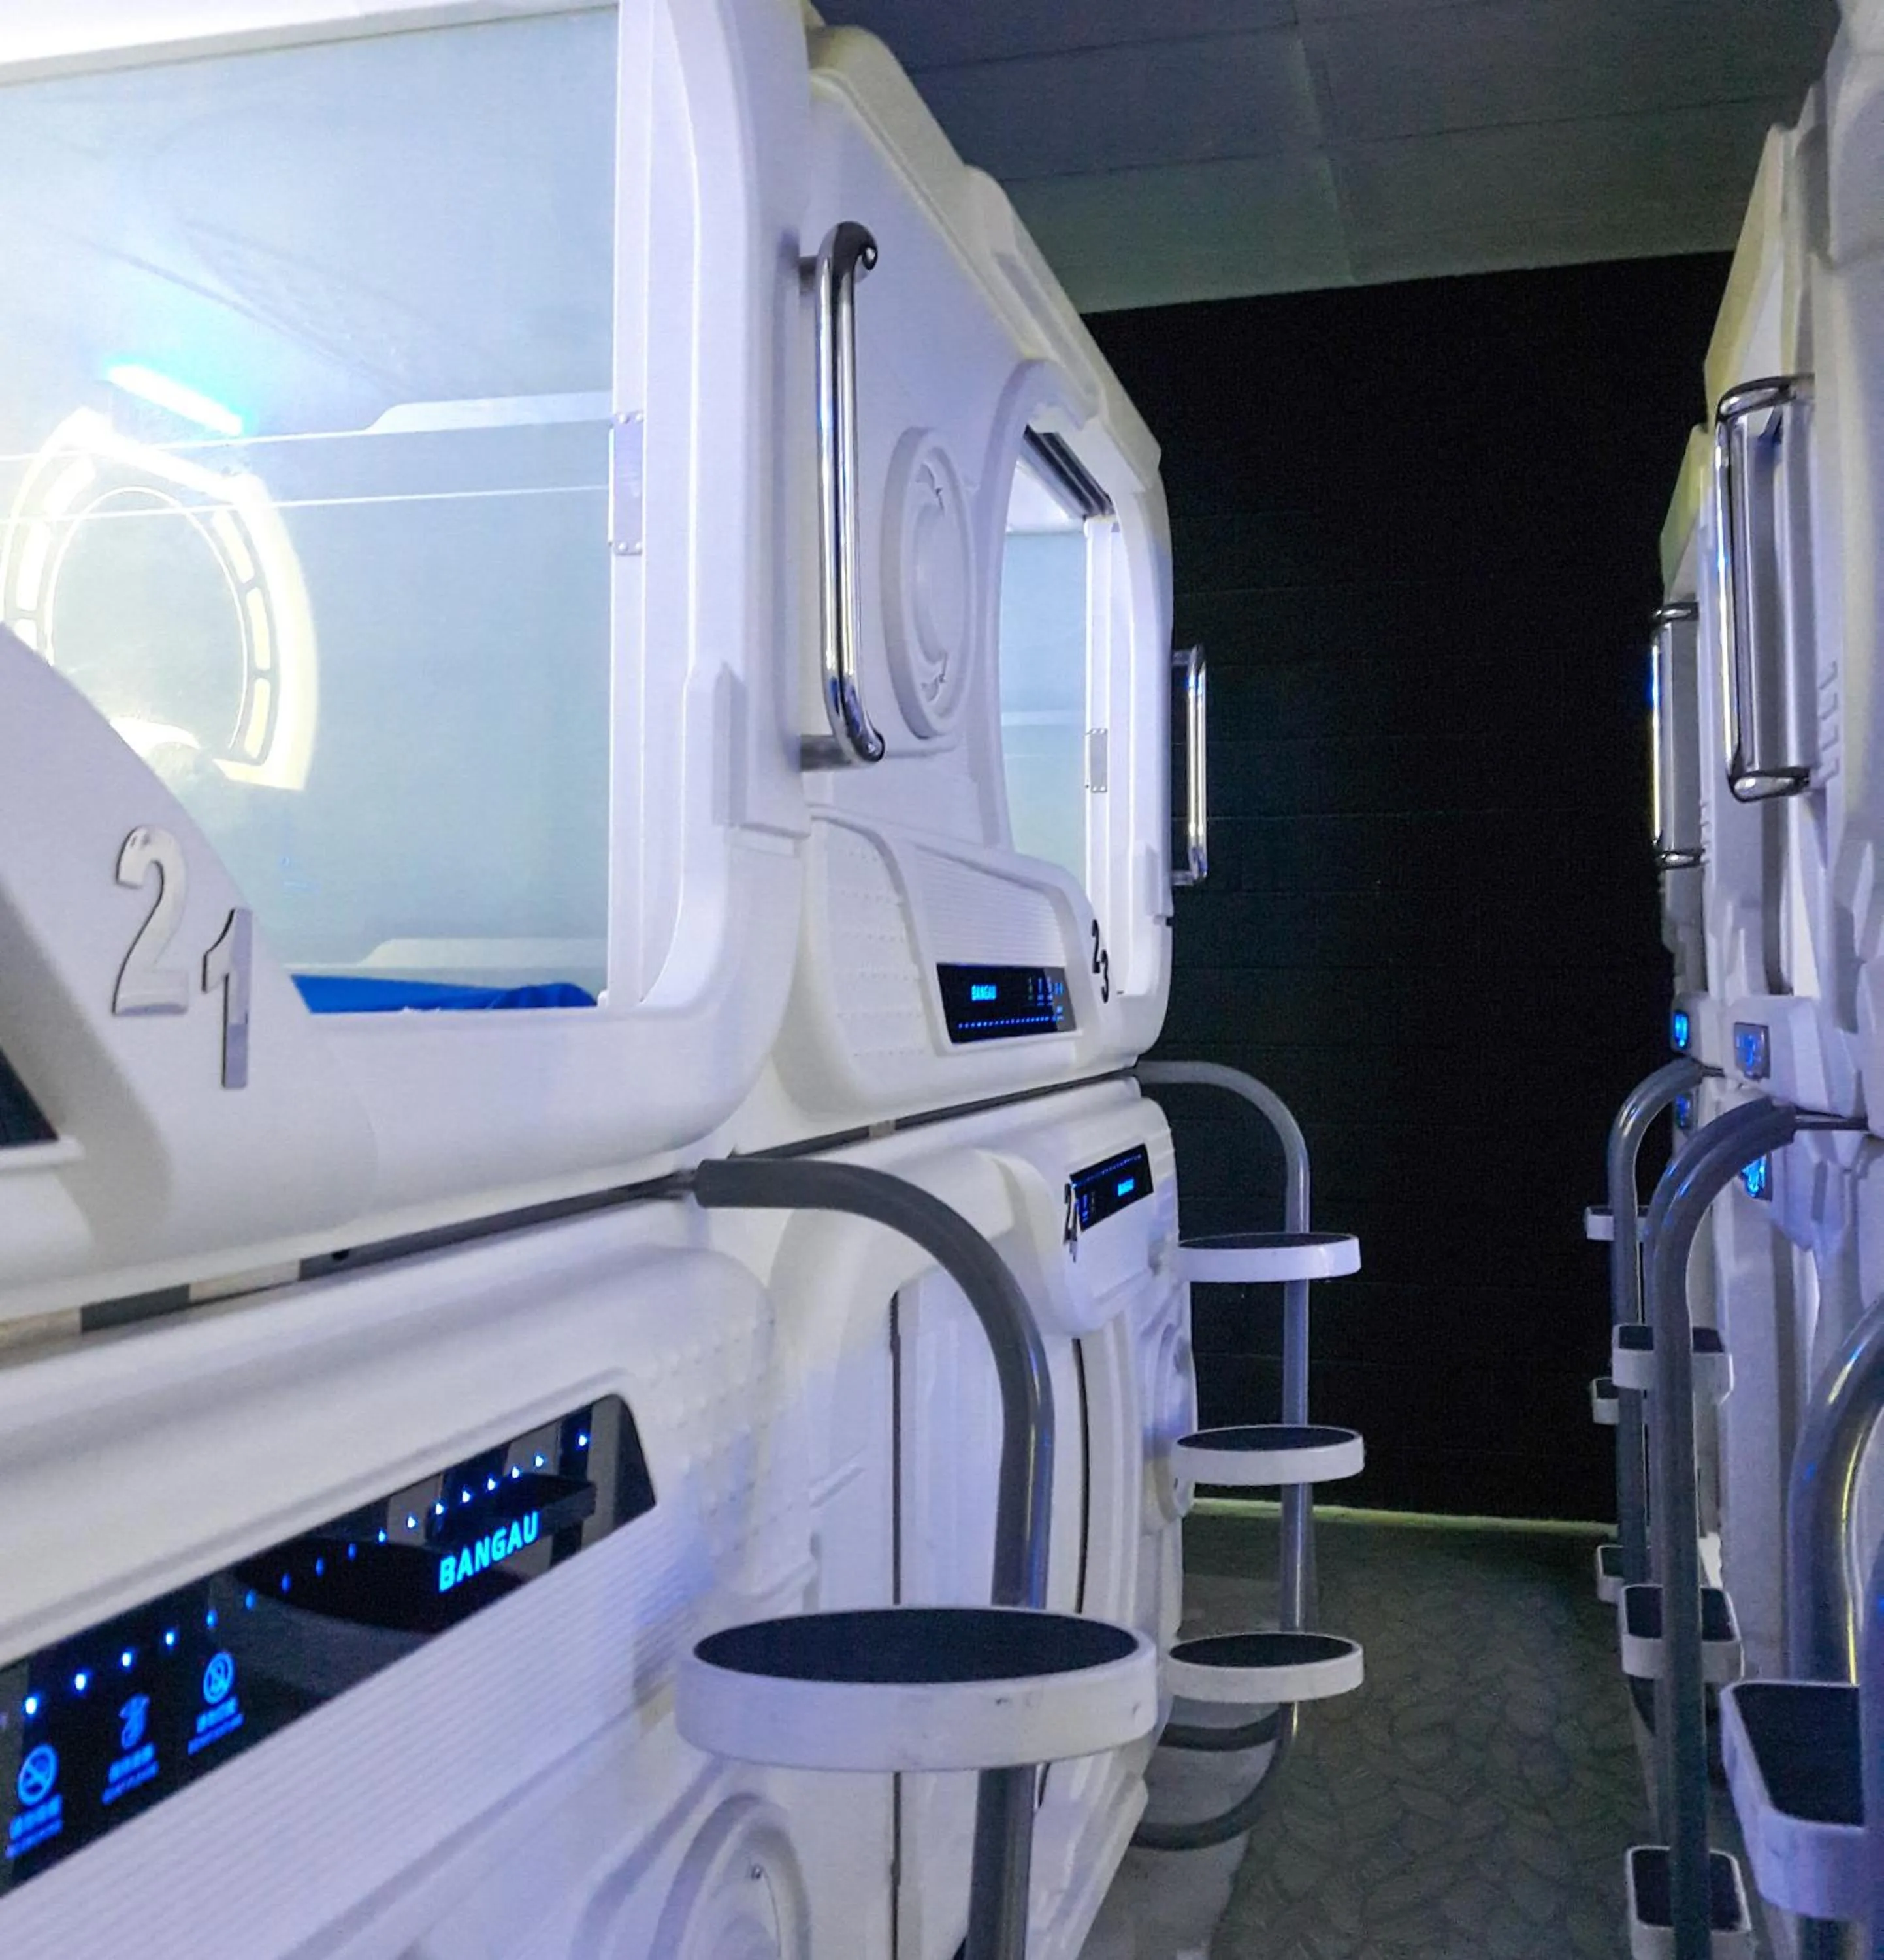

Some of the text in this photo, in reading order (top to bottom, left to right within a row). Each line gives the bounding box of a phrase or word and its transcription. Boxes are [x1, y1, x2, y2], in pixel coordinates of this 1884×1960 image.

[112, 824, 253, 1089] 21
[1092, 919, 1109, 1004] 23
[439, 1510, 540, 1592] BANGAU
